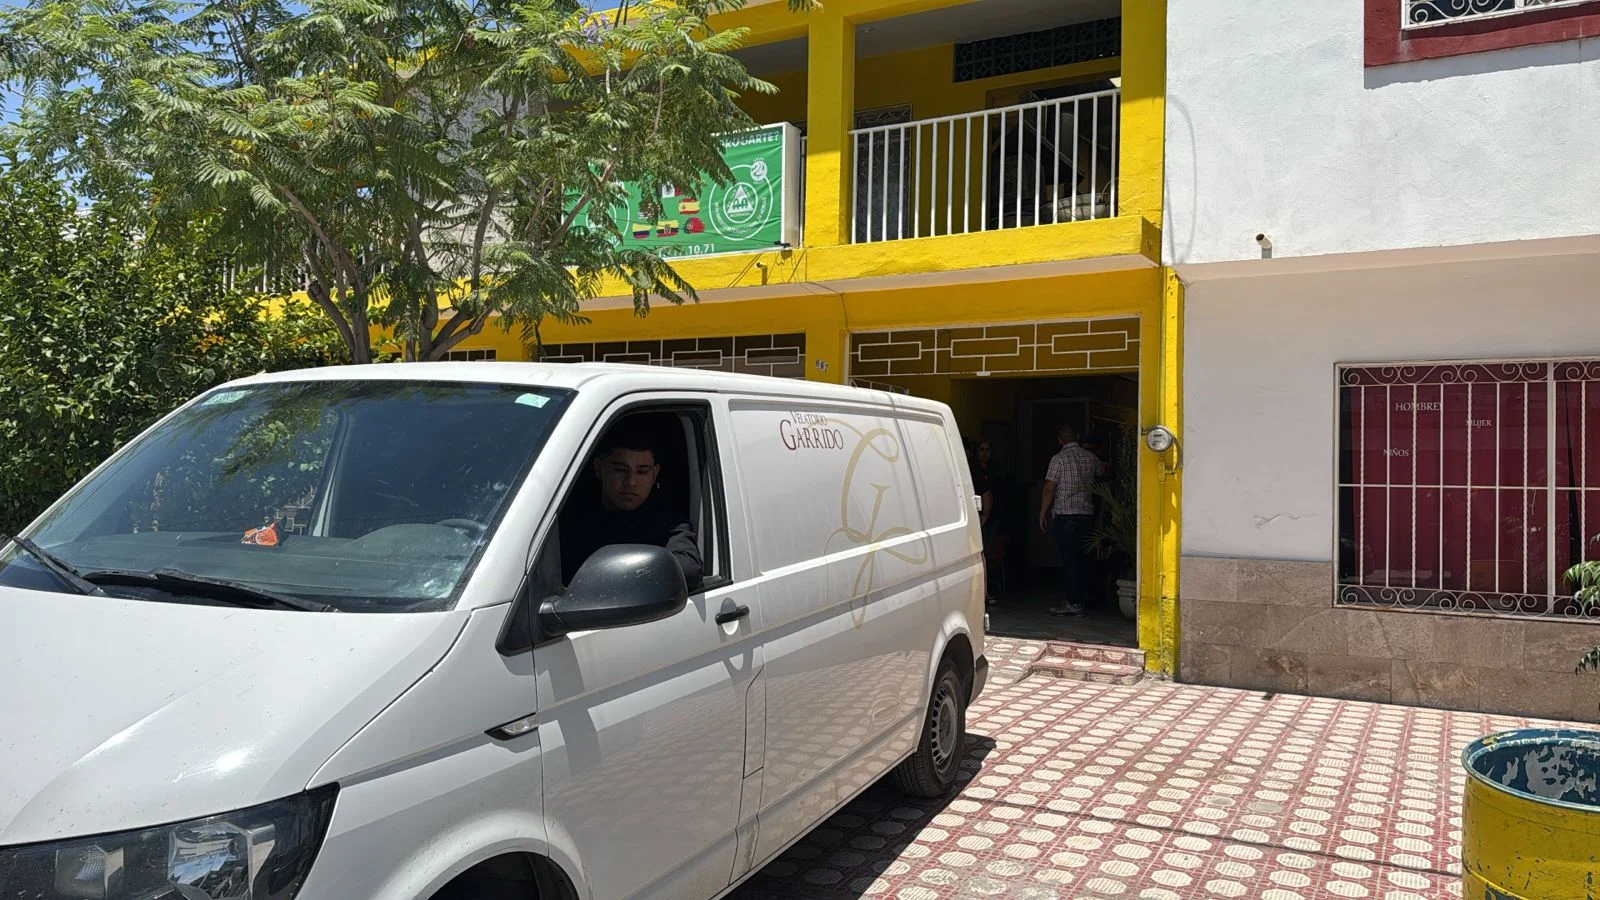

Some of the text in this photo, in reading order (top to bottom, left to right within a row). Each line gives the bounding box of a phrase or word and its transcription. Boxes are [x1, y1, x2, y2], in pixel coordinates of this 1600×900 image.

[688, 243, 715, 255] 10.71
[790, 410, 828, 426] VELATORIO
[1466, 419, 1493, 429] MUJER
[780, 419, 844, 450] GARRIDO
[1383, 447, 1410, 457] NIÑOS
